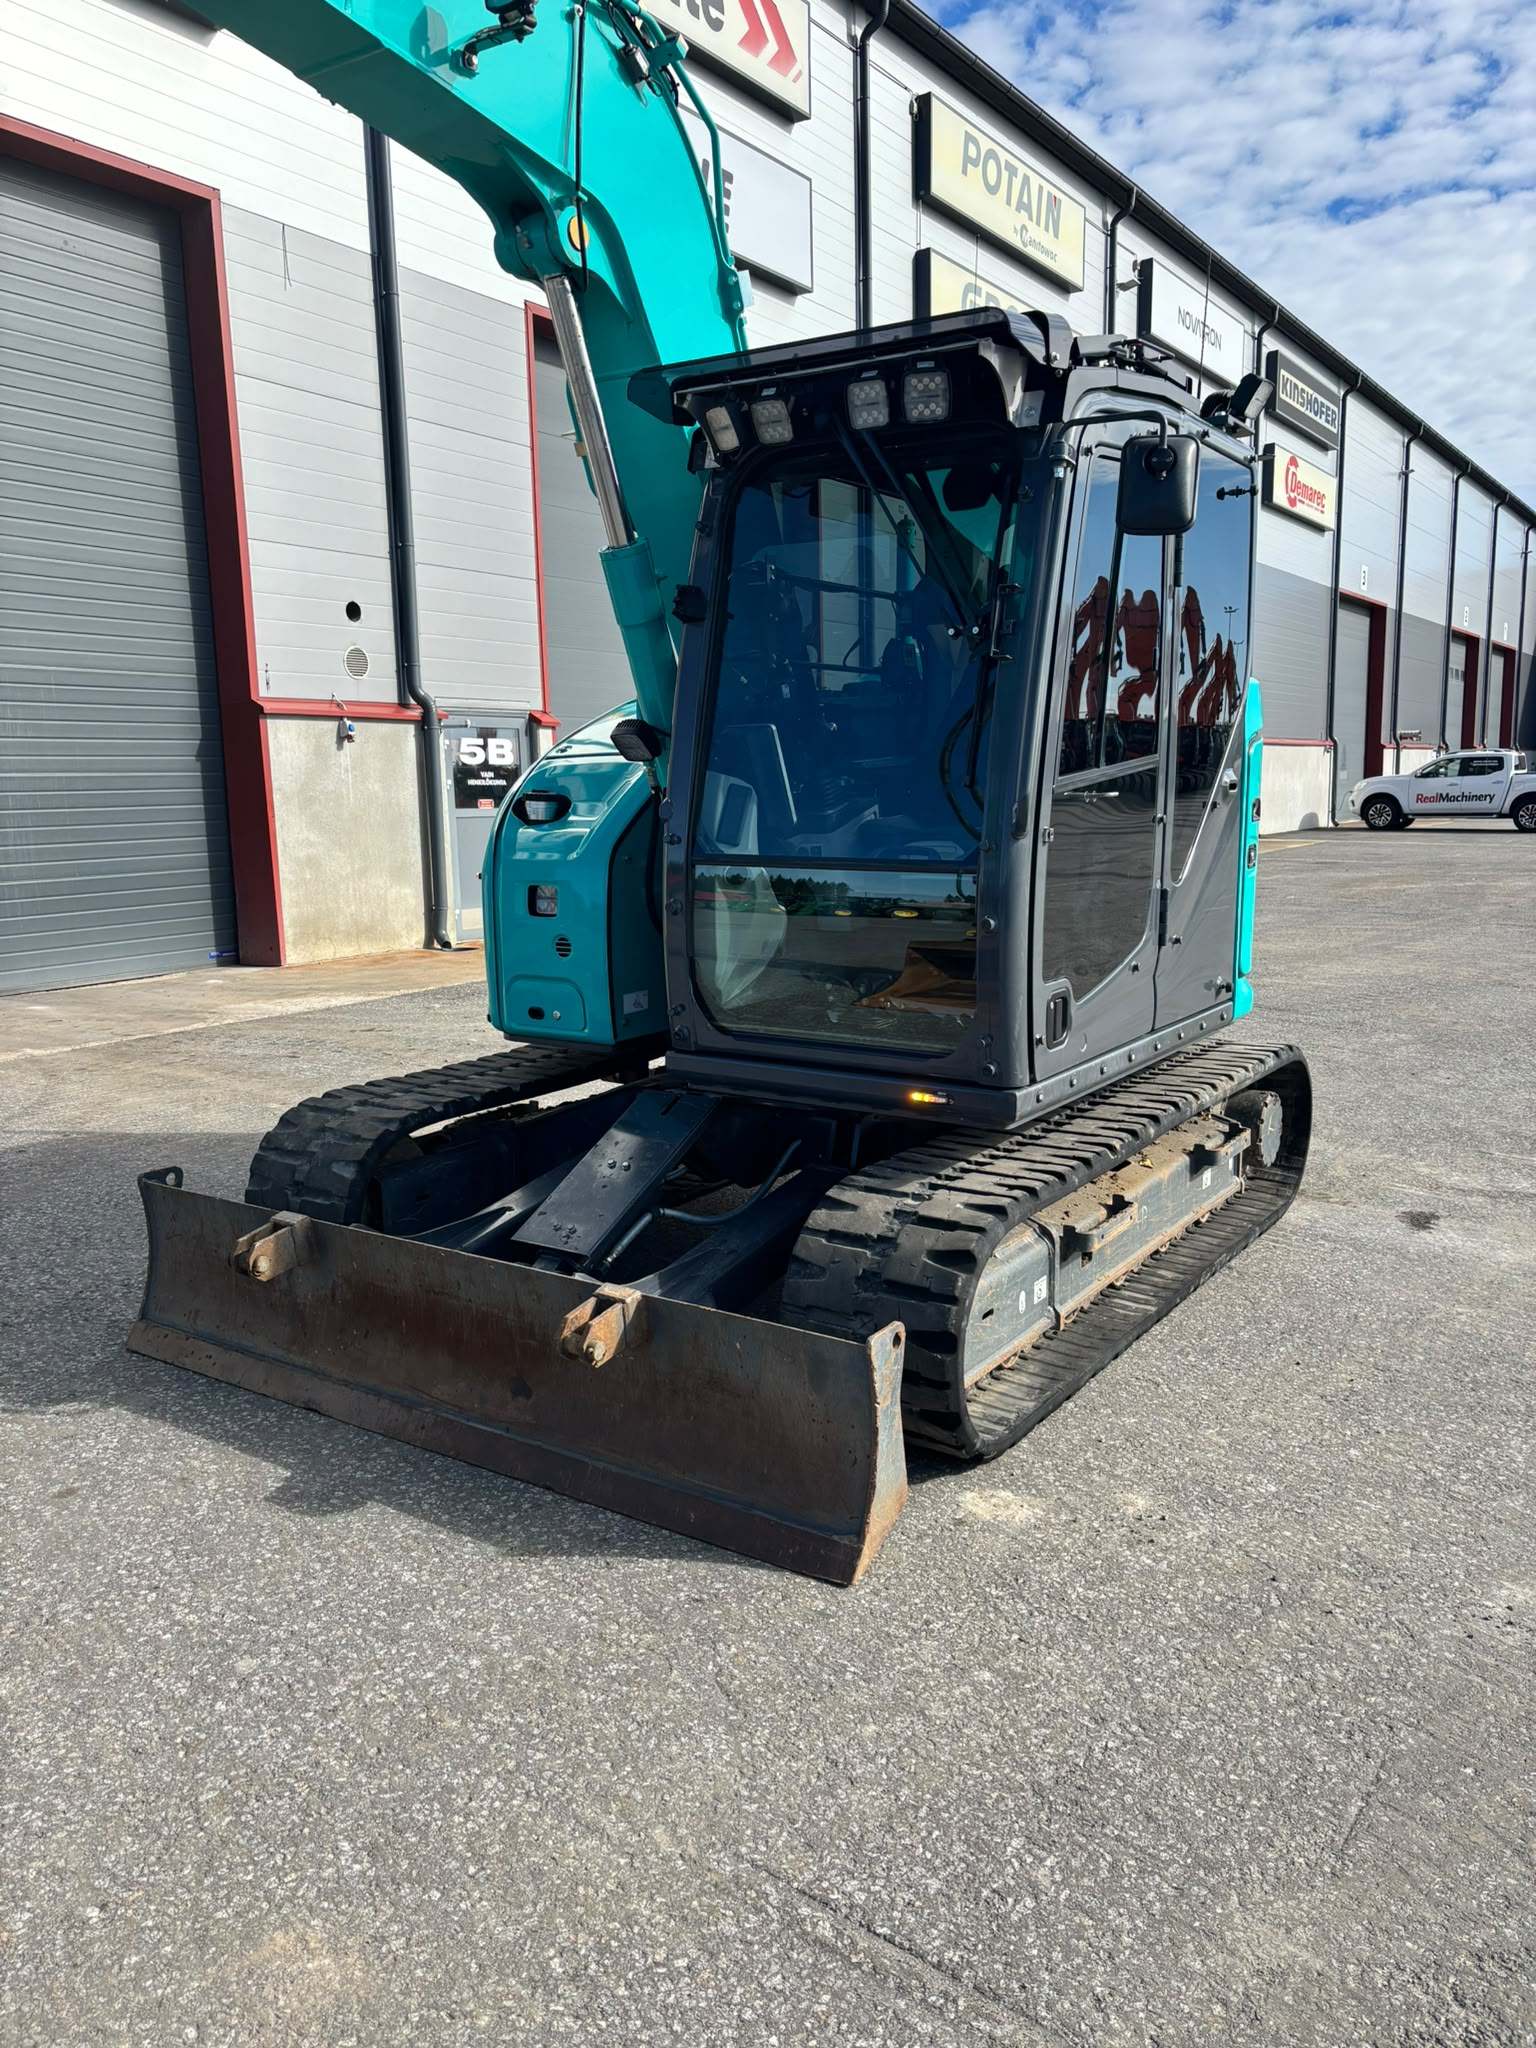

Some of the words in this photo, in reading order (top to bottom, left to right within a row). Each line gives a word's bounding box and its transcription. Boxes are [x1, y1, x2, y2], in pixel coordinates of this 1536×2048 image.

[962, 130, 1062, 240] POTAIN
[1177, 306, 1222, 351] NOVATRON
[1281, 374, 1337, 429] KINSHOFER
[1290, 471, 1326, 508] Demarec
[459, 737, 514, 766] 5B
[1416, 791, 1496, 804] RealMachinery
